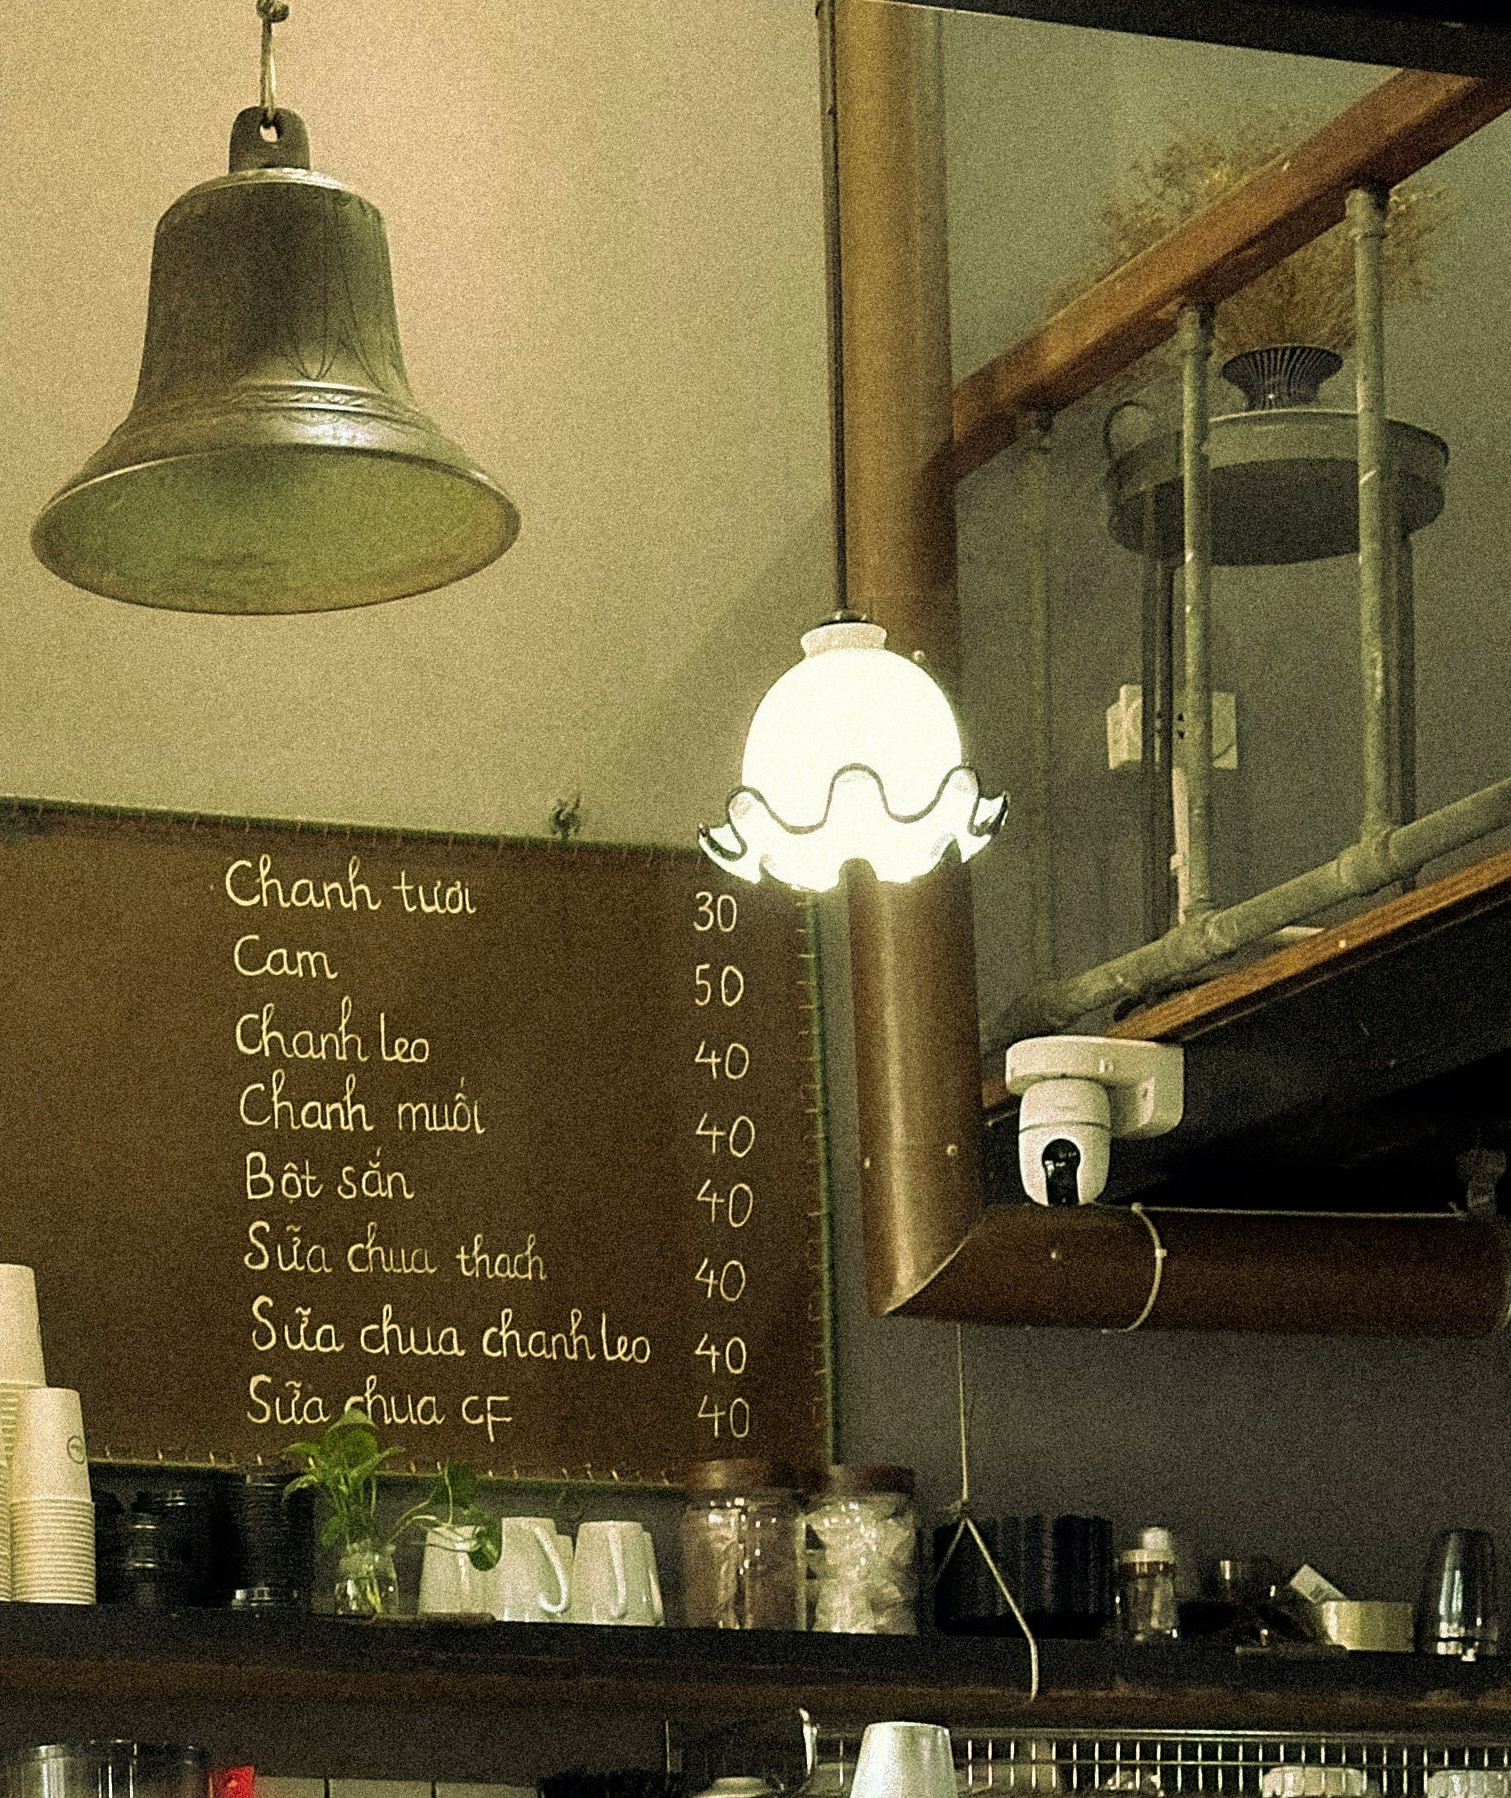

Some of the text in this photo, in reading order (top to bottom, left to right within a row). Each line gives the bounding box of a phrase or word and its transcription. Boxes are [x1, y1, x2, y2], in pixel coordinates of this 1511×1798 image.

[223, 853, 382, 912] Chanh
[692, 890, 739, 934] 30
[232, 933, 339, 981] Cam
[694, 962, 746, 1008] 50
[234, 994, 431, 1065] Chanh leo
[693, 1040, 751, 1081] 40
[238, 1067, 375, 1133] Chanh
[693, 1112, 757, 1160] 40
[244, 1150, 324, 1203] Bột
[695, 1178, 755, 1229] 40
[345, 1220, 438, 1275] chua
[693, 1256, 747, 1303] 40
[358, 1302, 467, 1358] chua
[693, 1332, 748, 1376] 40
[460, 1394, 513, 1443] CF
[696, 1394, 750, 1439] 40
